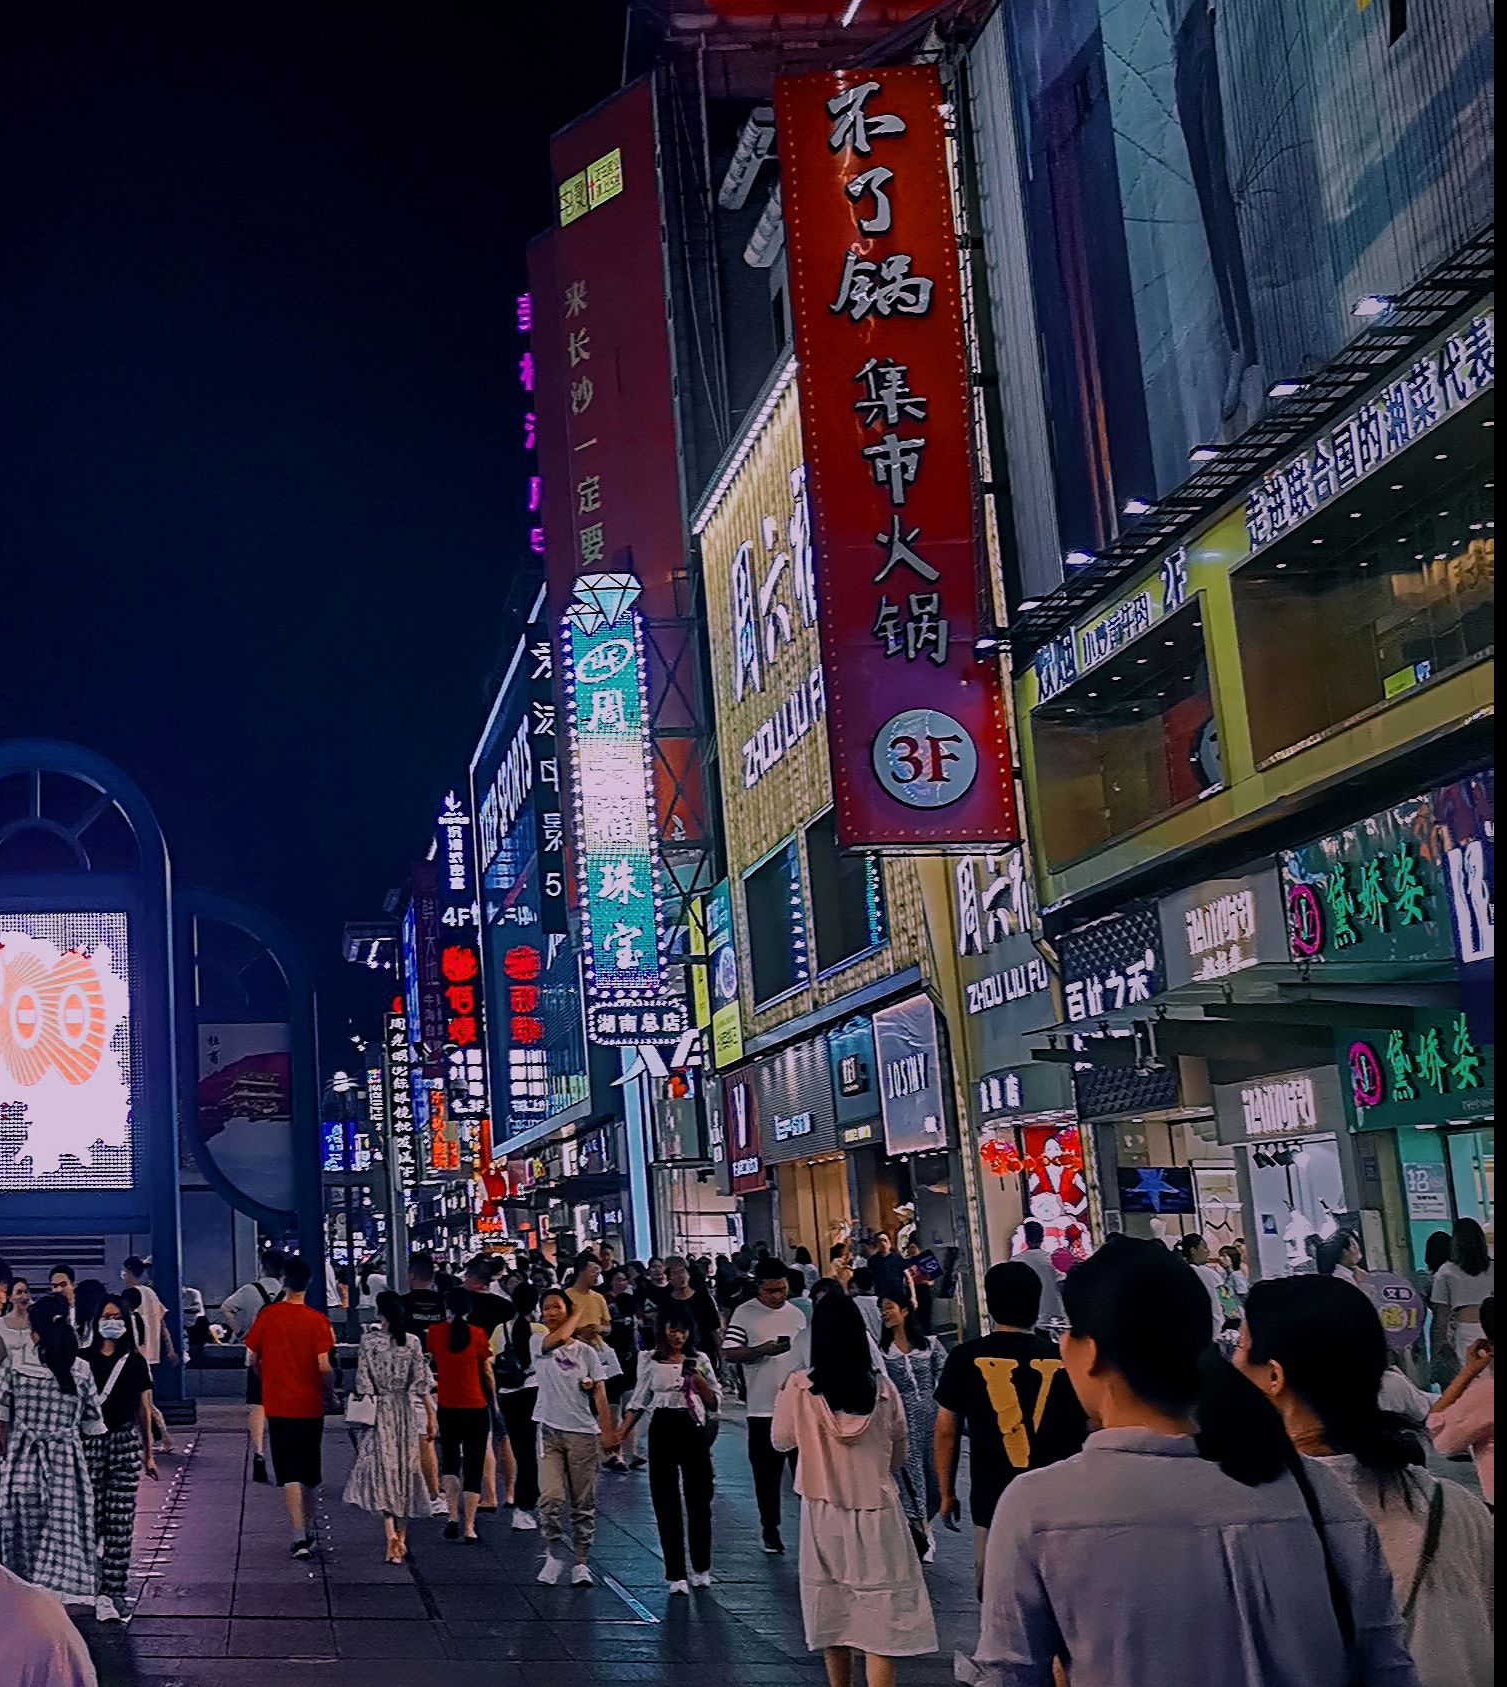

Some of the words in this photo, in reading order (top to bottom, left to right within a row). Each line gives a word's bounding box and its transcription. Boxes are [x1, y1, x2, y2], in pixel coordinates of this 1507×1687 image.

[564, 279, 604, 567] 来长沙一定要
[853, 357, 949, 666] 集市火锅
[742, 710, 782, 789] ZHOU
[782, 682, 809, 749] LIU
[890, 735, 962, 783] 3F
[597, 1012, 682, 1034] 湖南总店
[967, 976, 1002, 1014] ZHOU
[1003, 965, 1027, 1002] LIU
[1028, 959, 1048, 994] FU
[972, 1356, 1066, 1468] V
